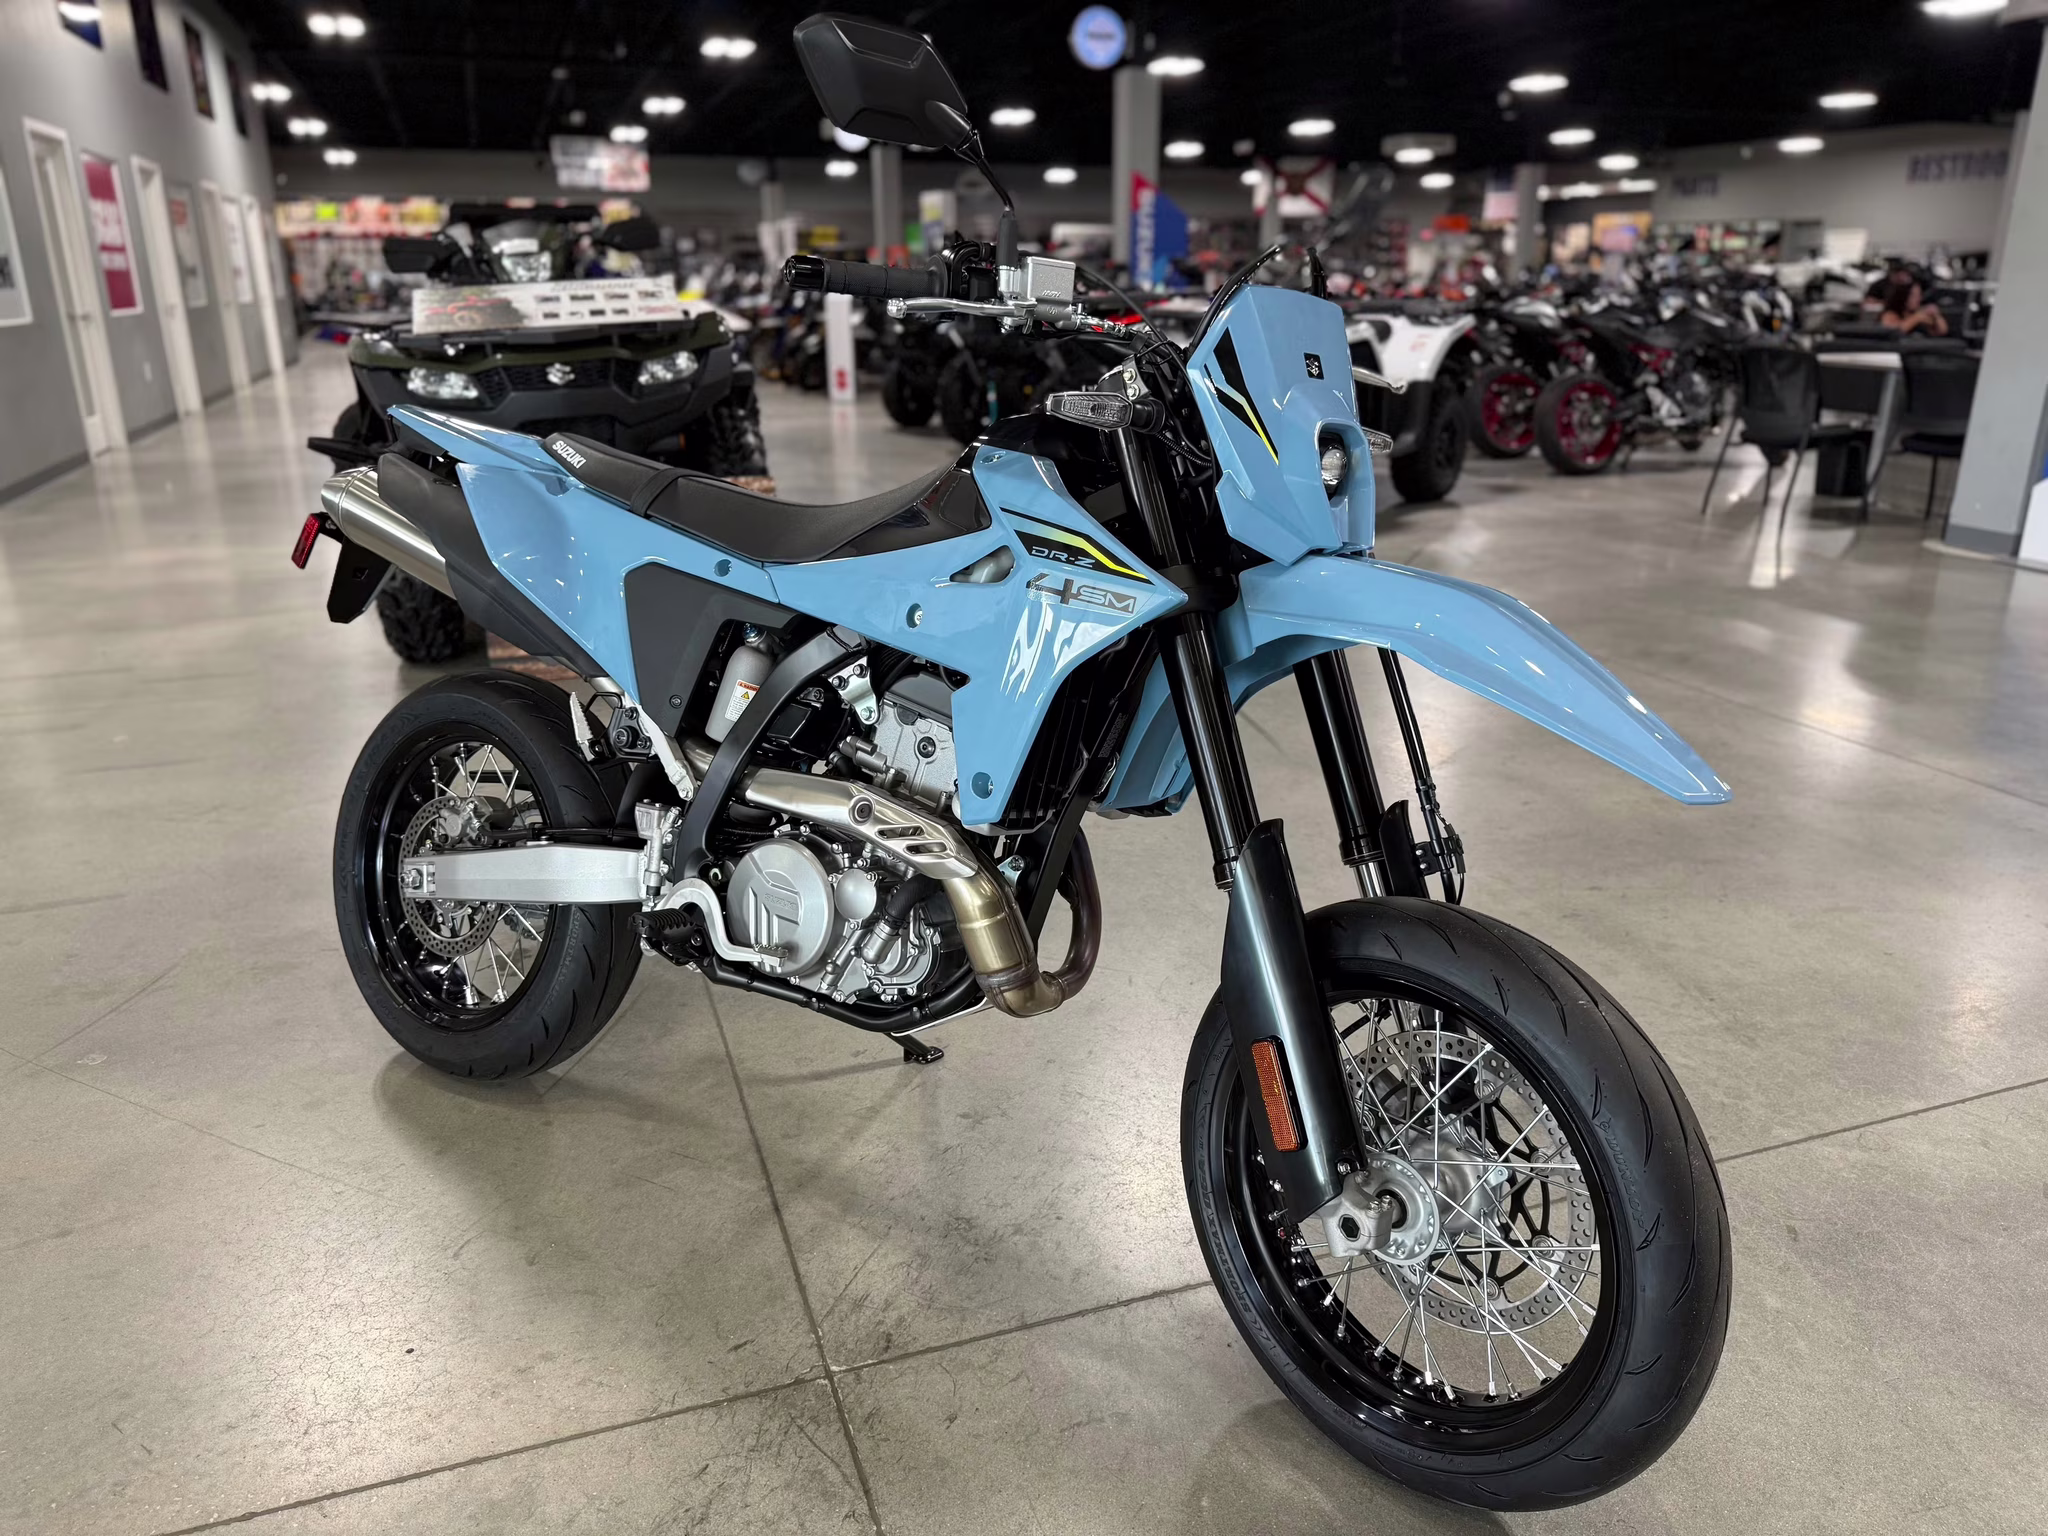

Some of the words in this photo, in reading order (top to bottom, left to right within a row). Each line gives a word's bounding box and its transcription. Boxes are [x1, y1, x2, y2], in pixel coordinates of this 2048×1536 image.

[552, 440, 587, 469] SUZUKI
[1031, 545, 1096, 568] DR-Z
[1605, 1135, 1645, 1230] DUNLOP
[1207, 1213, 1252, 1313] SPORTMAX
